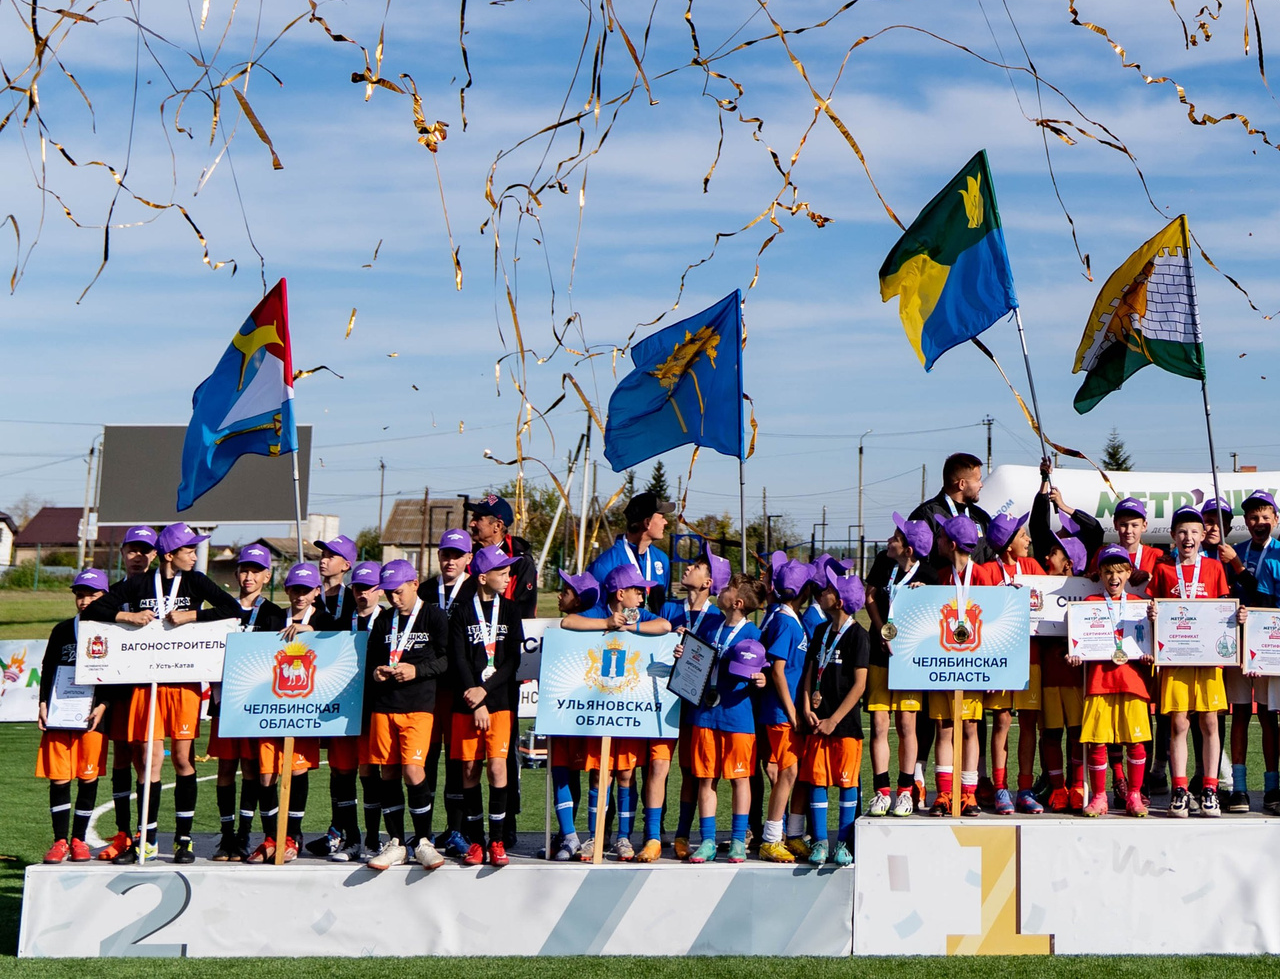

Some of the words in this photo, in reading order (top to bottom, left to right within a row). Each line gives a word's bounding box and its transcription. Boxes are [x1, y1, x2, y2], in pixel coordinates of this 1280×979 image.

[121, 640, 226, 652] ВАГОНОСТРОИТЕЛЬ
[155, 662, 195, 670] Усть-Катав
[912, 656, 1008, 668] ЧЕЛЯБИНСКАЯ
[929, 671, 991, 682] ОБЛАСТЬ
[243, 702, 341, 715] ЧЕЛЯБИНСКАЯ
[557, 699, 663, 712] УЛЬЯНОВСКАЯ
[259, 718, 322, 729] ОБЛАСТЬ
[575, 715, 641, 727] ОБЛАСТЬ
[100, 871, 192, 957] 2
